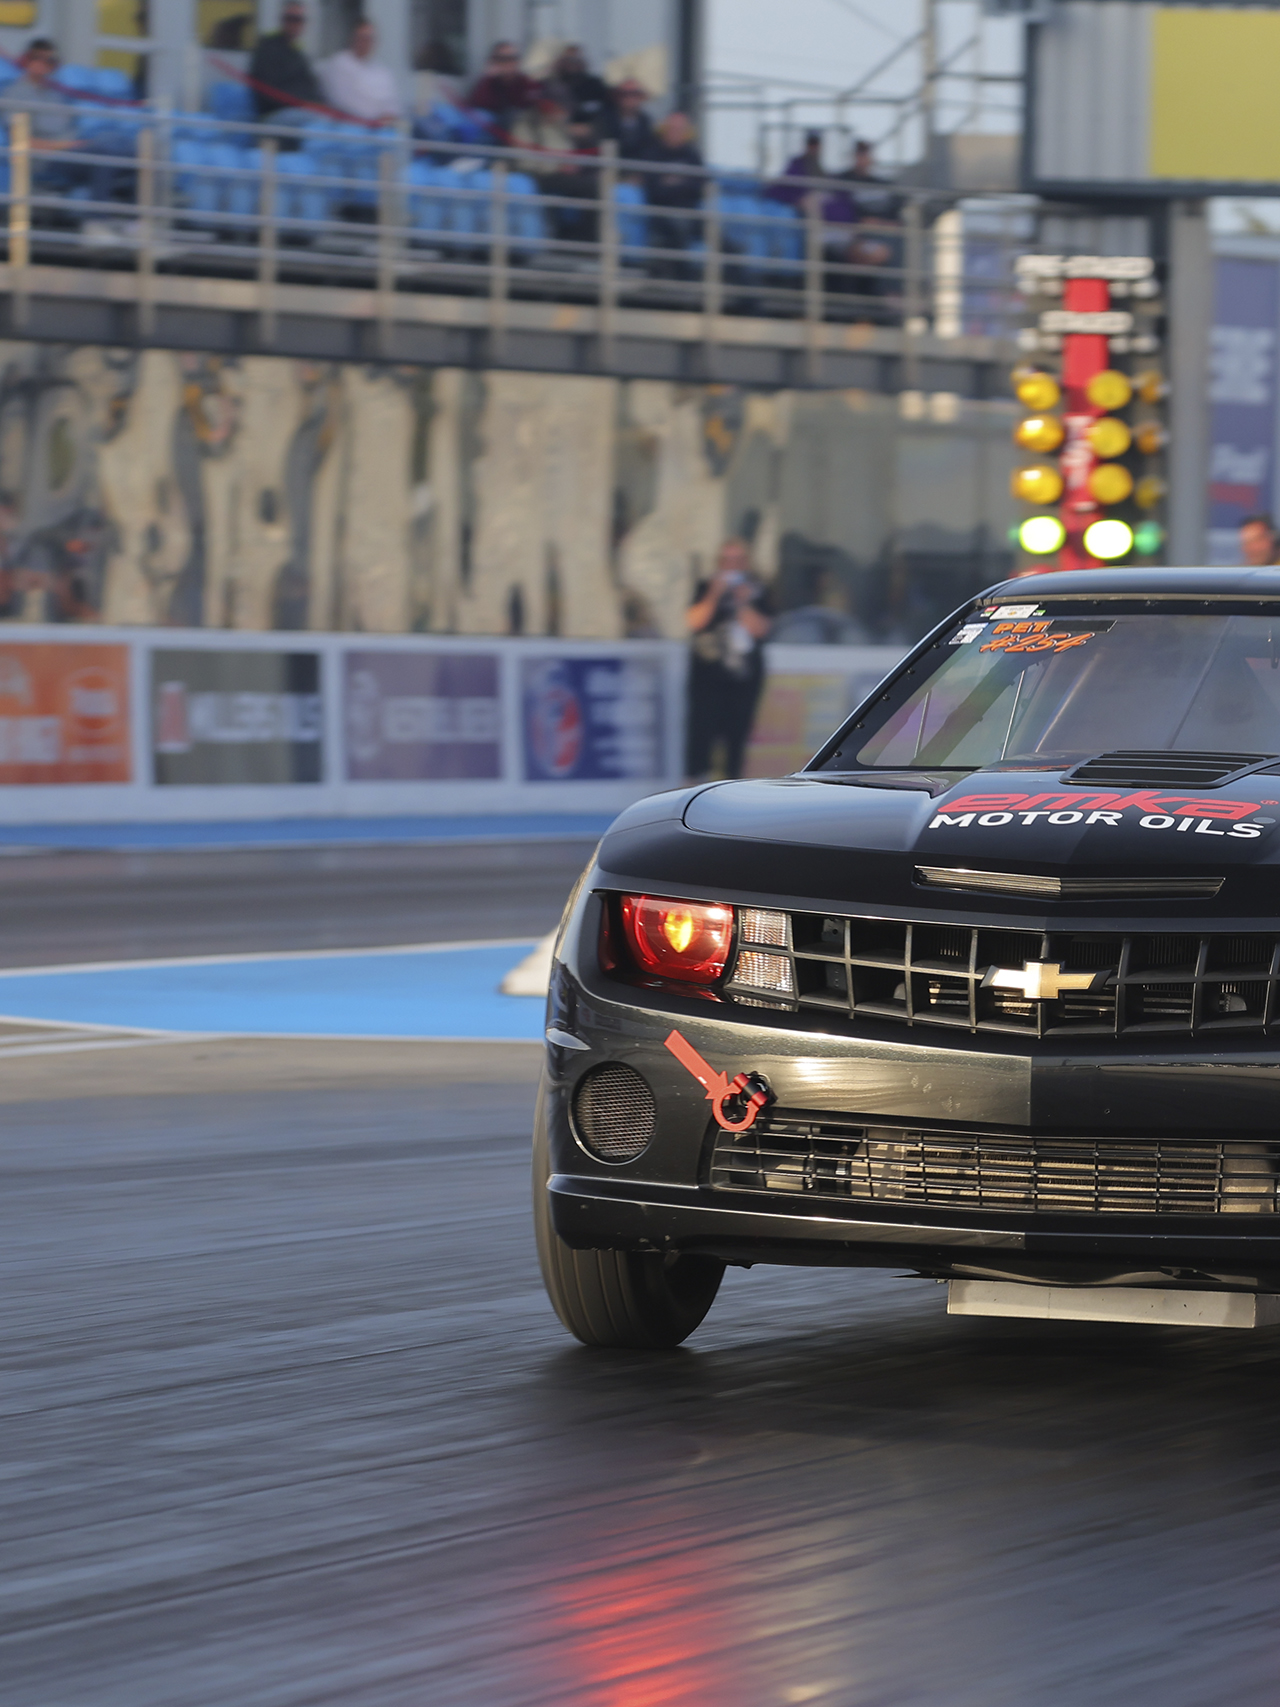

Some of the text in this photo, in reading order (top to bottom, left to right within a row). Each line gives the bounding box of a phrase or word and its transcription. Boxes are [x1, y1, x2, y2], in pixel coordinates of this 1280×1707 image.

[992, 620, 1053, 635] PET
[937, 790, 1263, 821] emka
[928, 810, 1265, 840] MOTOR OILS
